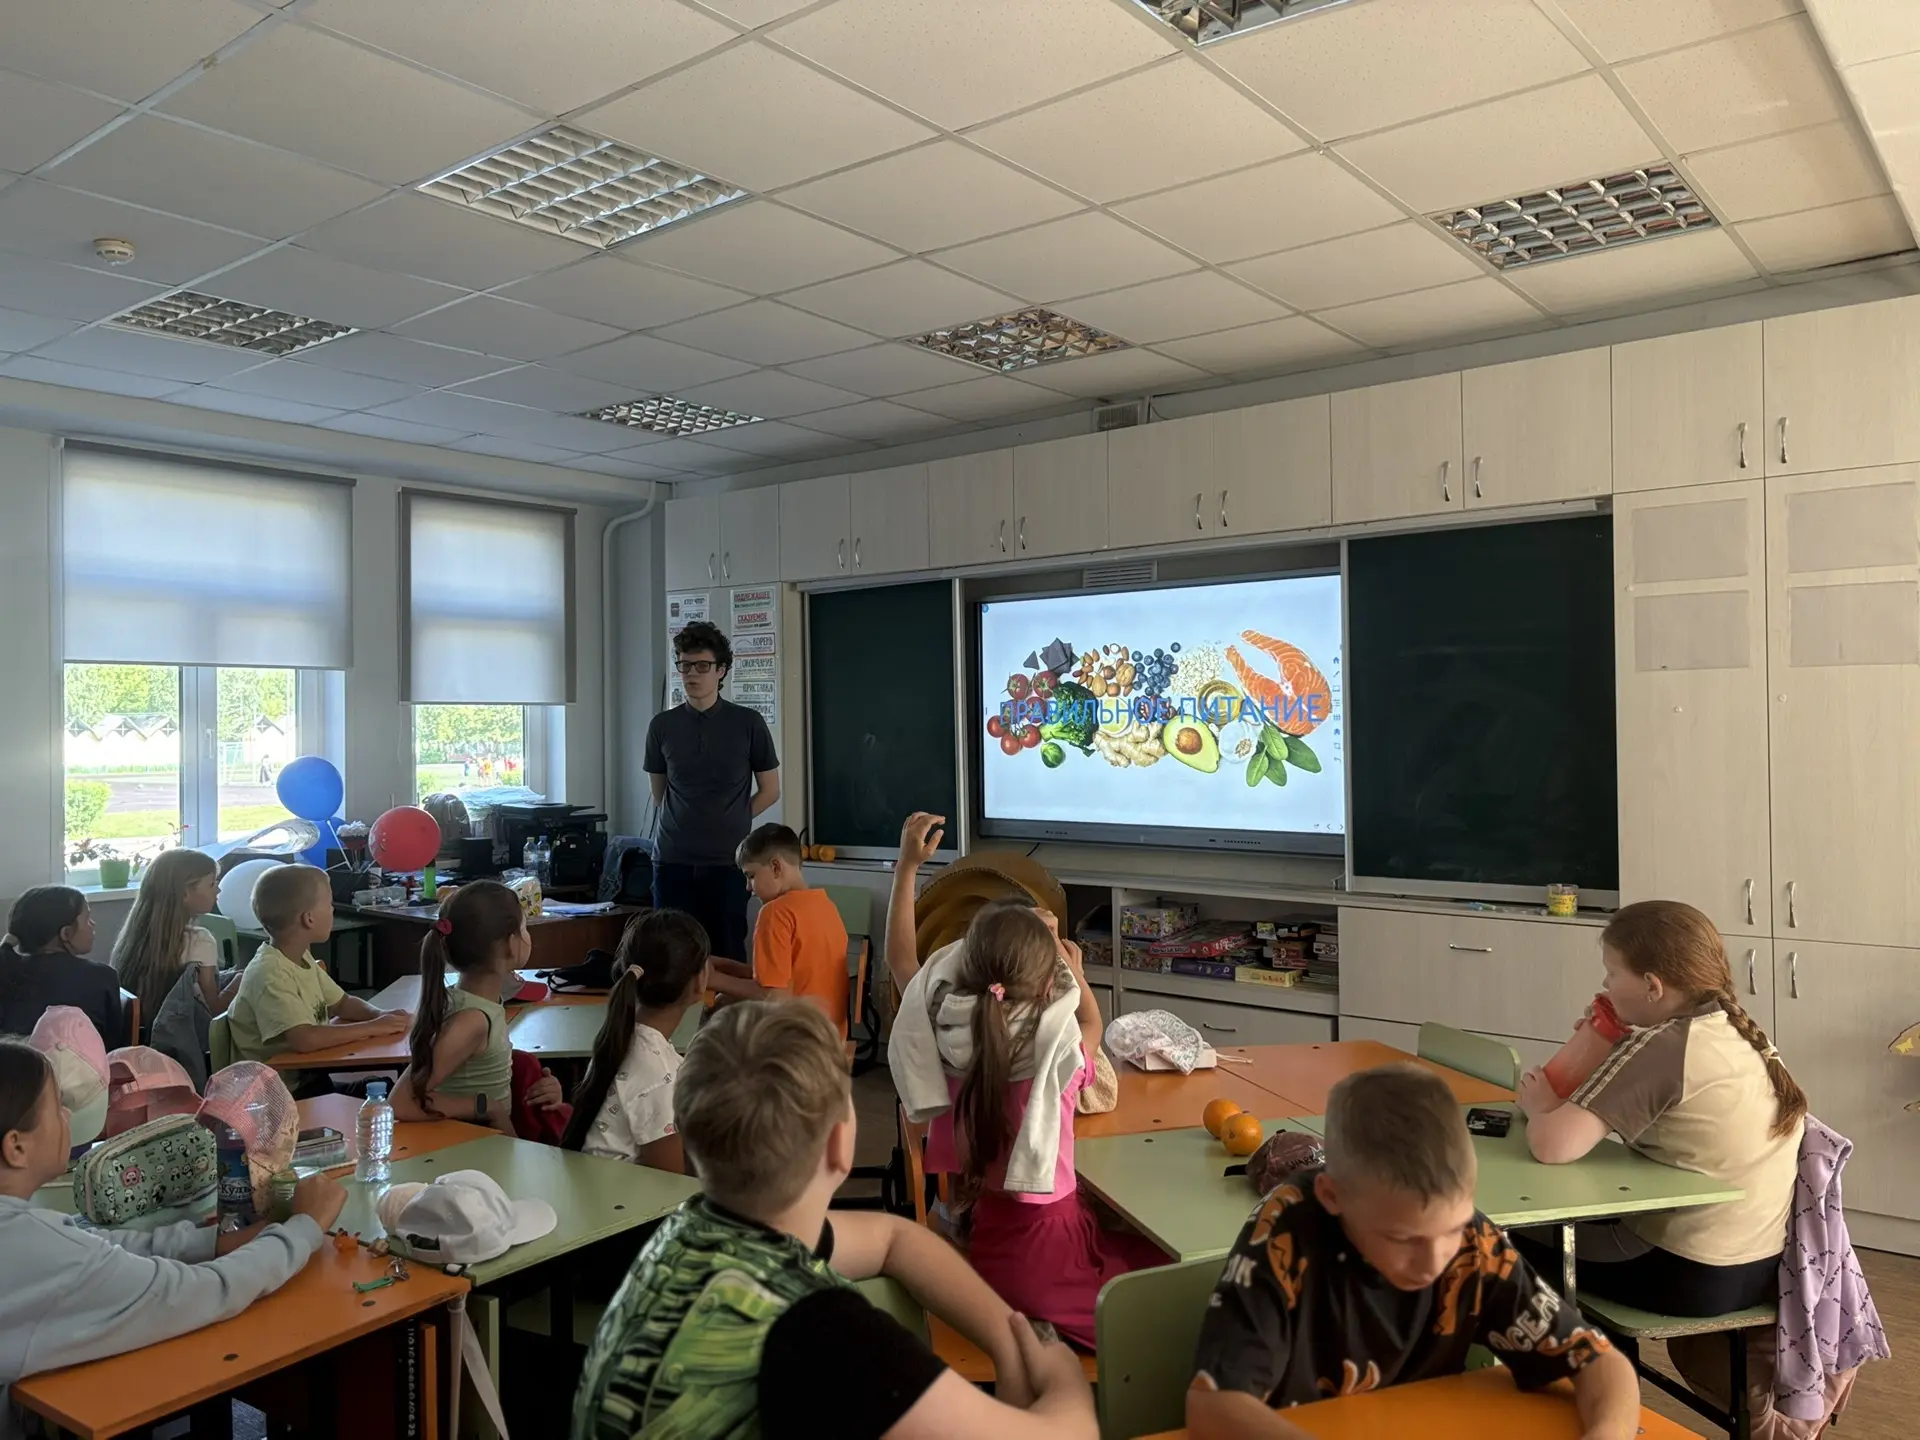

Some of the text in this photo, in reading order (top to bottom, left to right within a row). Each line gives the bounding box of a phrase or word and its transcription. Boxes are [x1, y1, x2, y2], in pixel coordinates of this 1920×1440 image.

[752, 636, 774, 646] КОРЕНЬ
[1000, 694, 1324, 726] ПРАВИЛЬНОЕ ПИТАНИЕ
